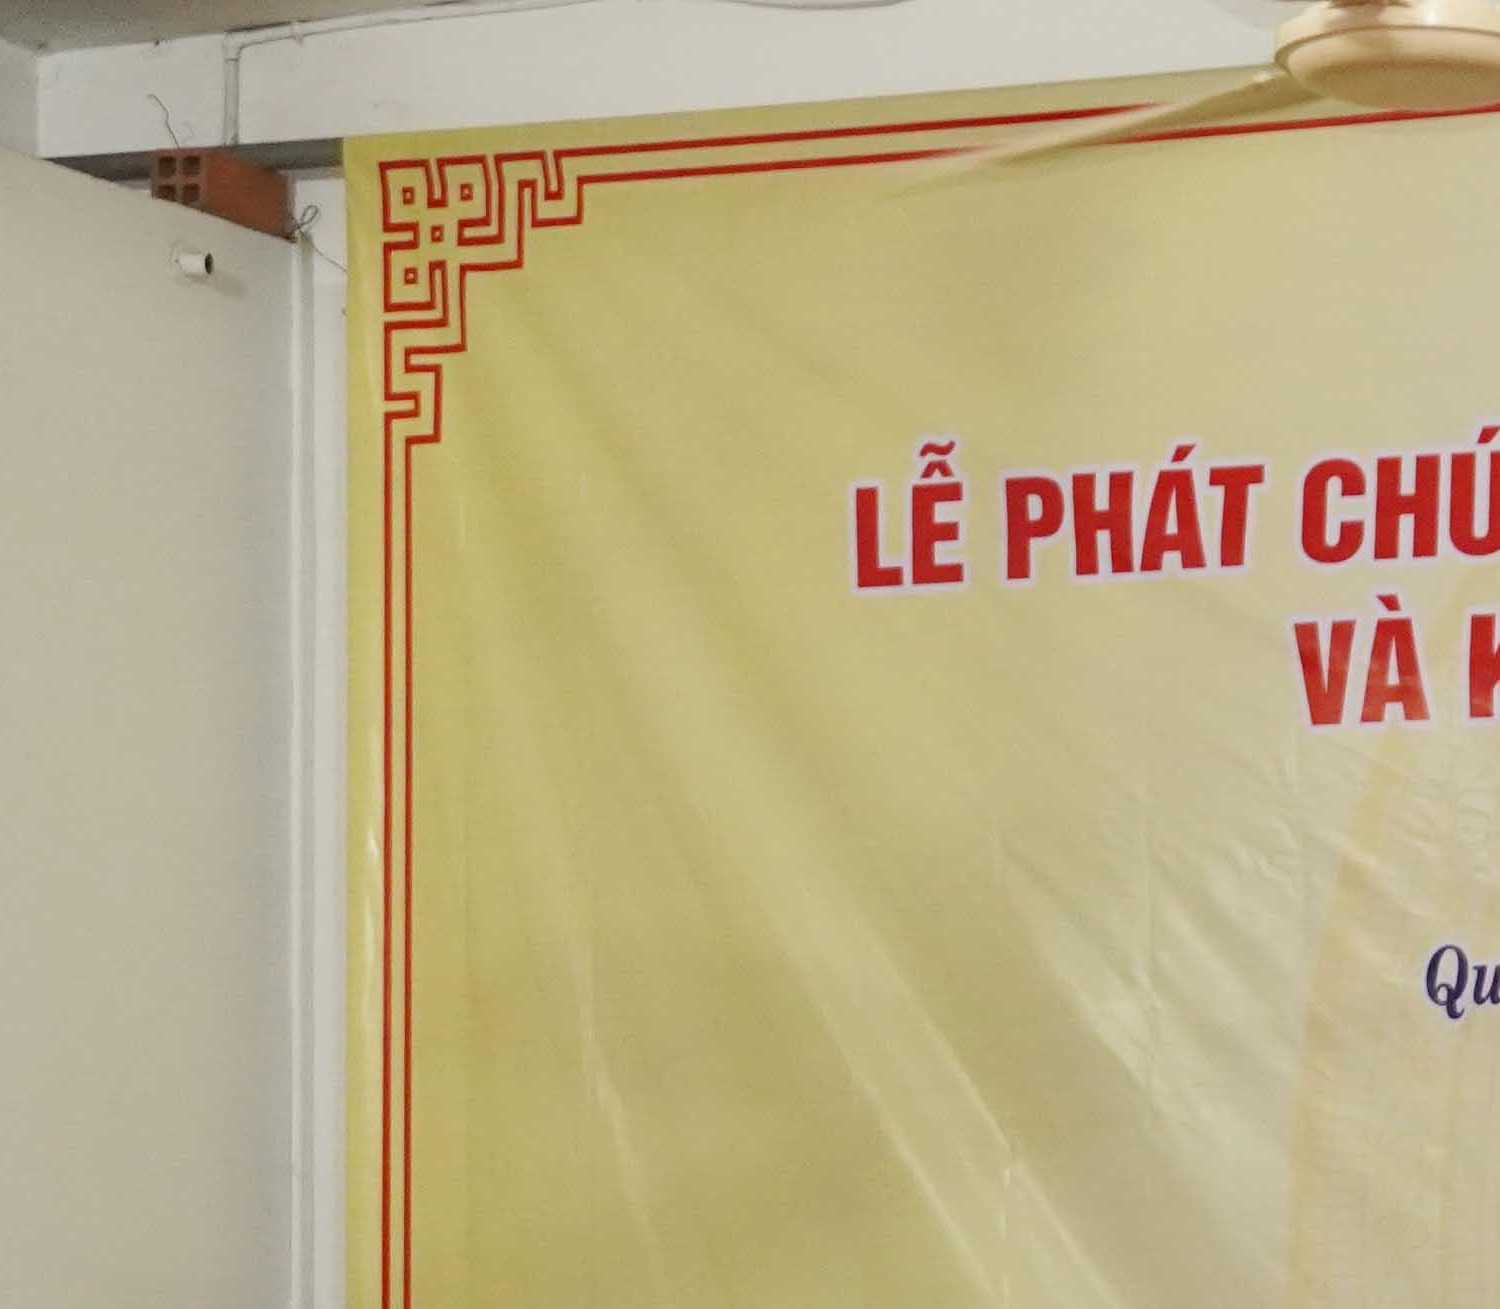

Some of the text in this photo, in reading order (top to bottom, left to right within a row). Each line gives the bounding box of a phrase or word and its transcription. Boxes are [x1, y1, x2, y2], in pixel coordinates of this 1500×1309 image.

[855, 440, 964, 589] LỄ
[1004, 443, 1264, 580] PHÁT
[1293, 594, 1431, 726] VÀ
